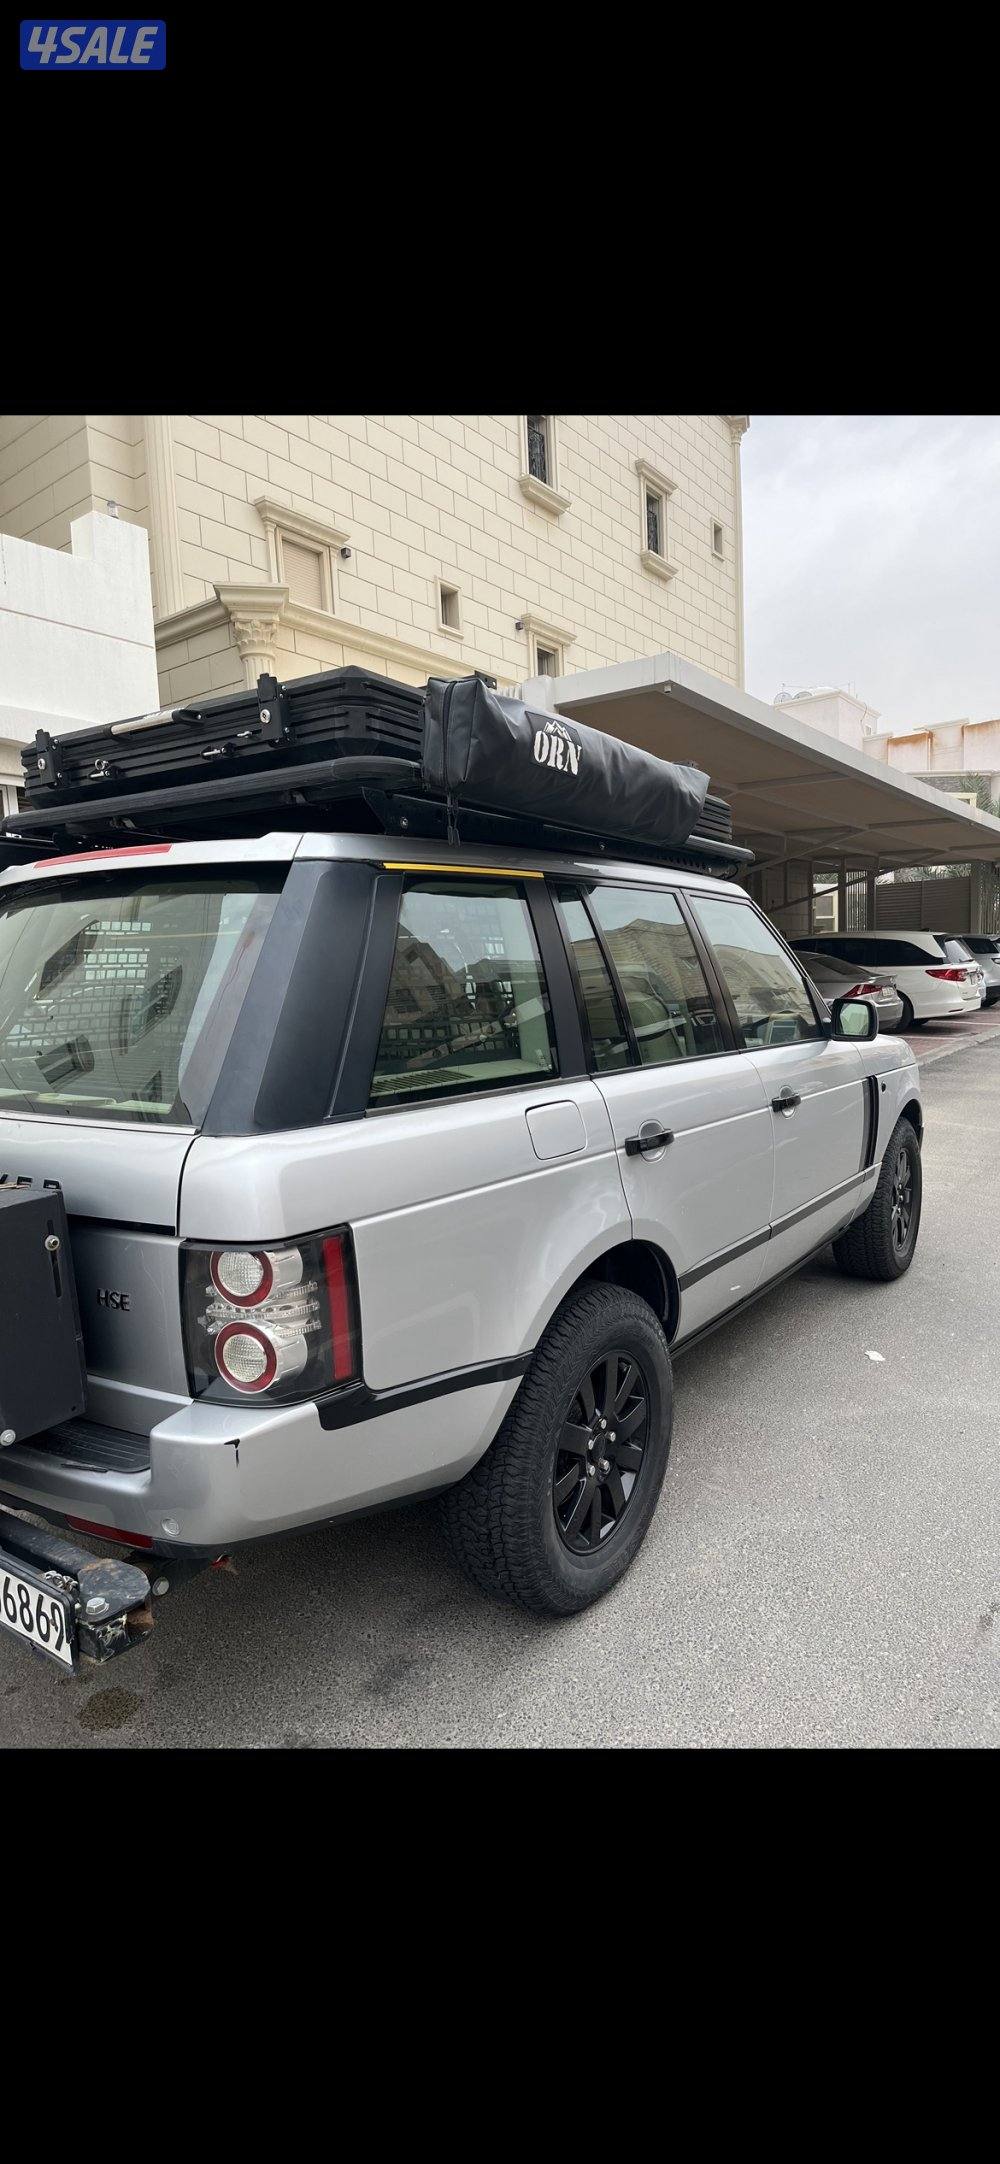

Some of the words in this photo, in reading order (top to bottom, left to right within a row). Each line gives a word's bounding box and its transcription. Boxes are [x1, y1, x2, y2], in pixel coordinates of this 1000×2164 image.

[533, 730, 582, 776] ORN
[97, 1288, 130, 1311] HSE
[0, 1575, 65, 1652] 6869
